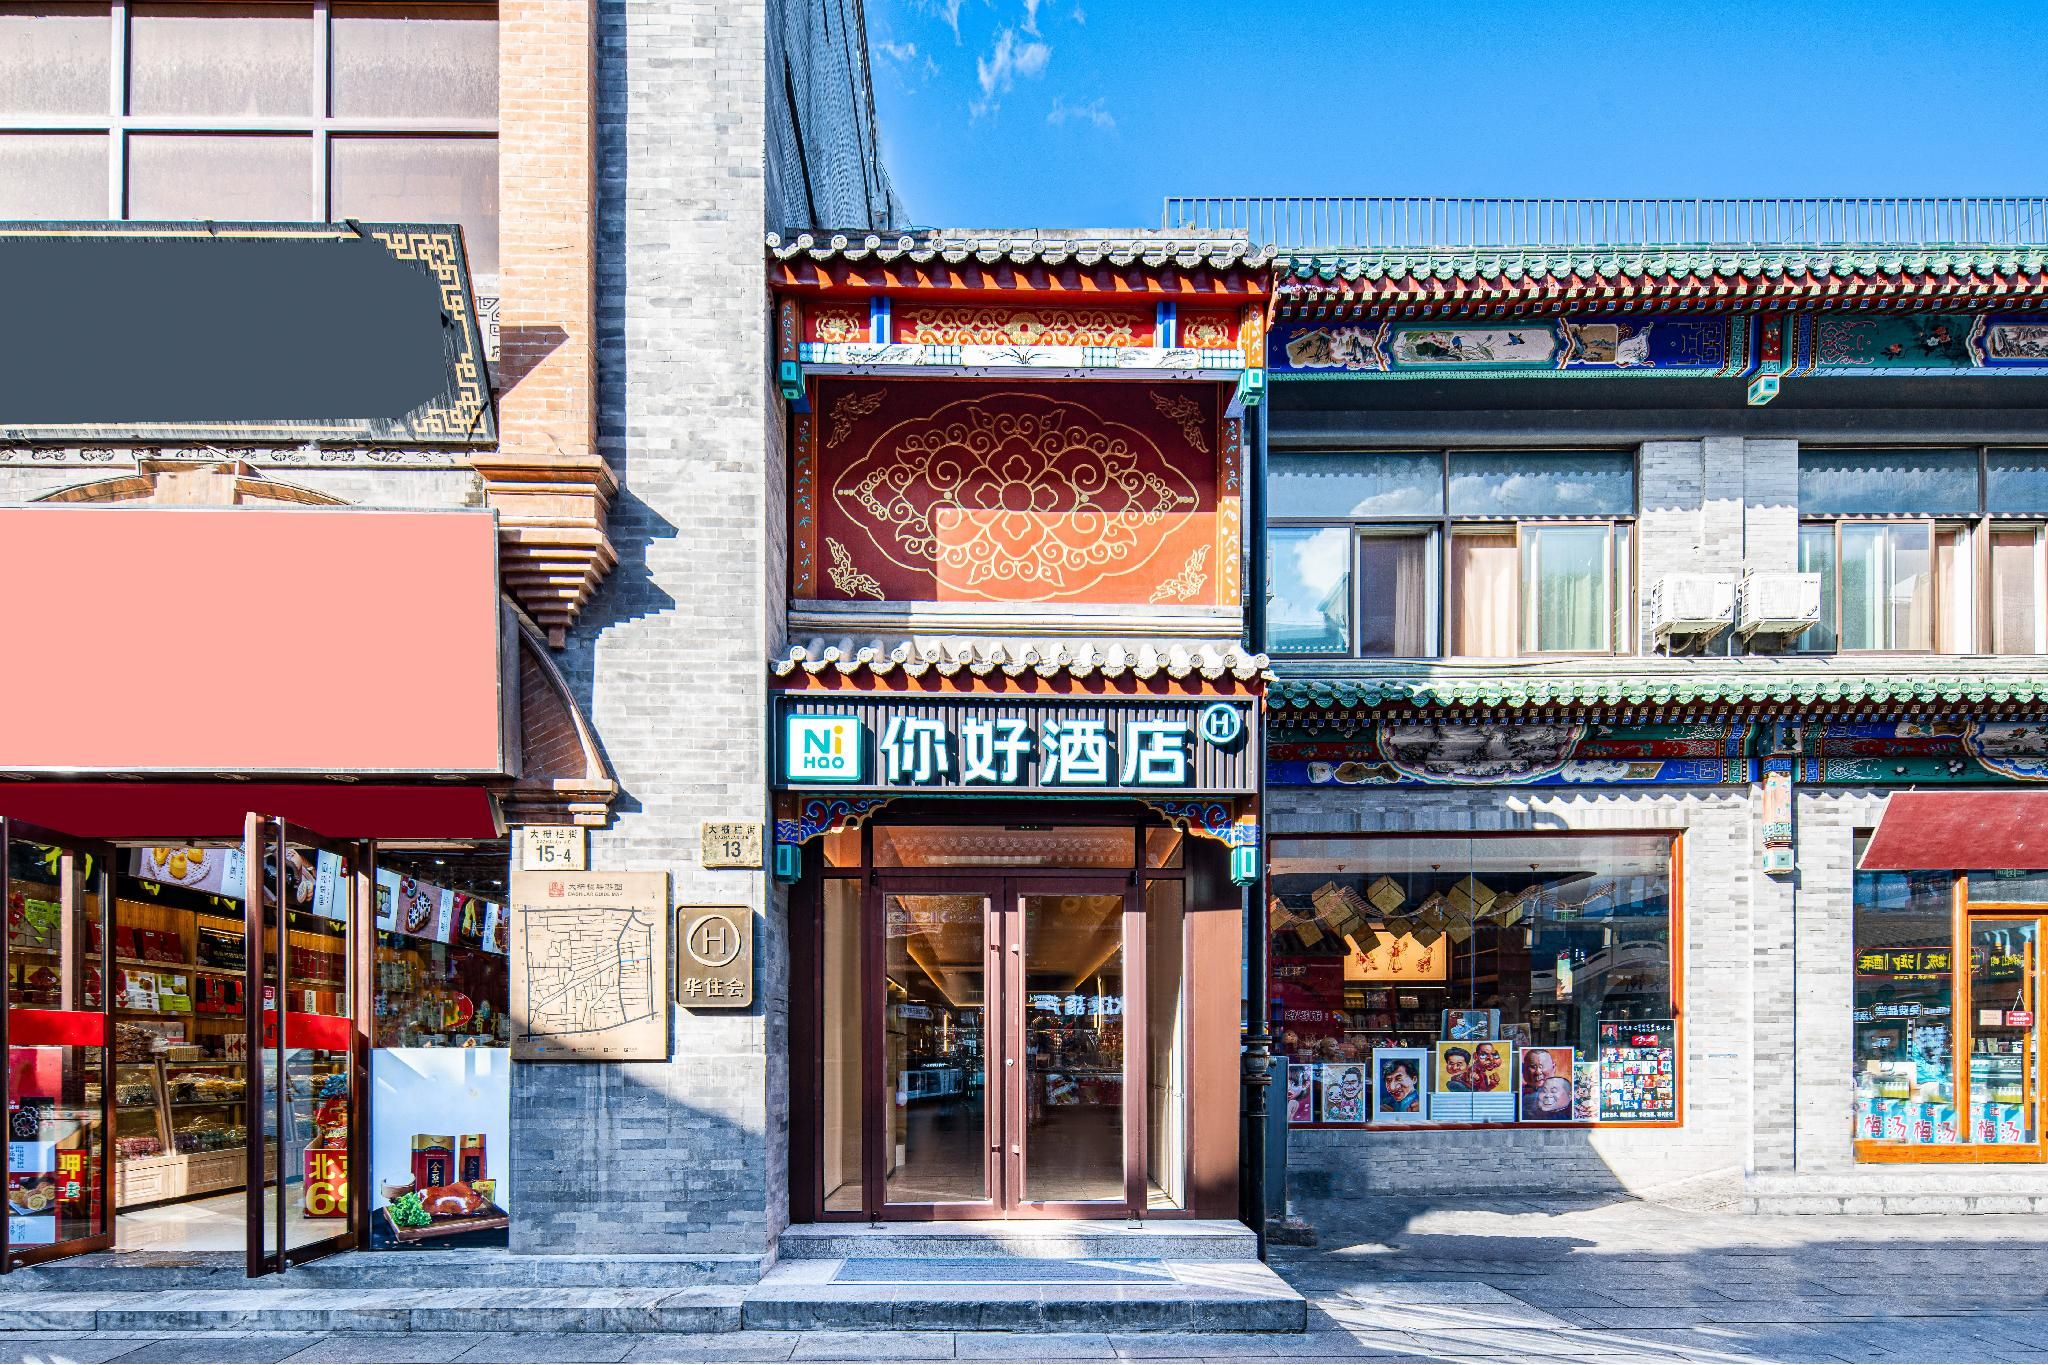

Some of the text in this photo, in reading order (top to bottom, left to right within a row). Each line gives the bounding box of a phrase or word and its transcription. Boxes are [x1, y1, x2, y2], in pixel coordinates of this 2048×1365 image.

[804, 724, 844, 755] Ni
[881, 715, 1188, 784] 你好酒店
[536, 845, 571, 862] 15-4
[722, 841, 741, 858] 13
[684, 977, 746, 998] 华住会
[1864, 1114, 1907, 1138] 梅汤
[1914, 1120, 1957, 1142] 梅汤
[1977, 1120, 2021, 1142] 梅汤
